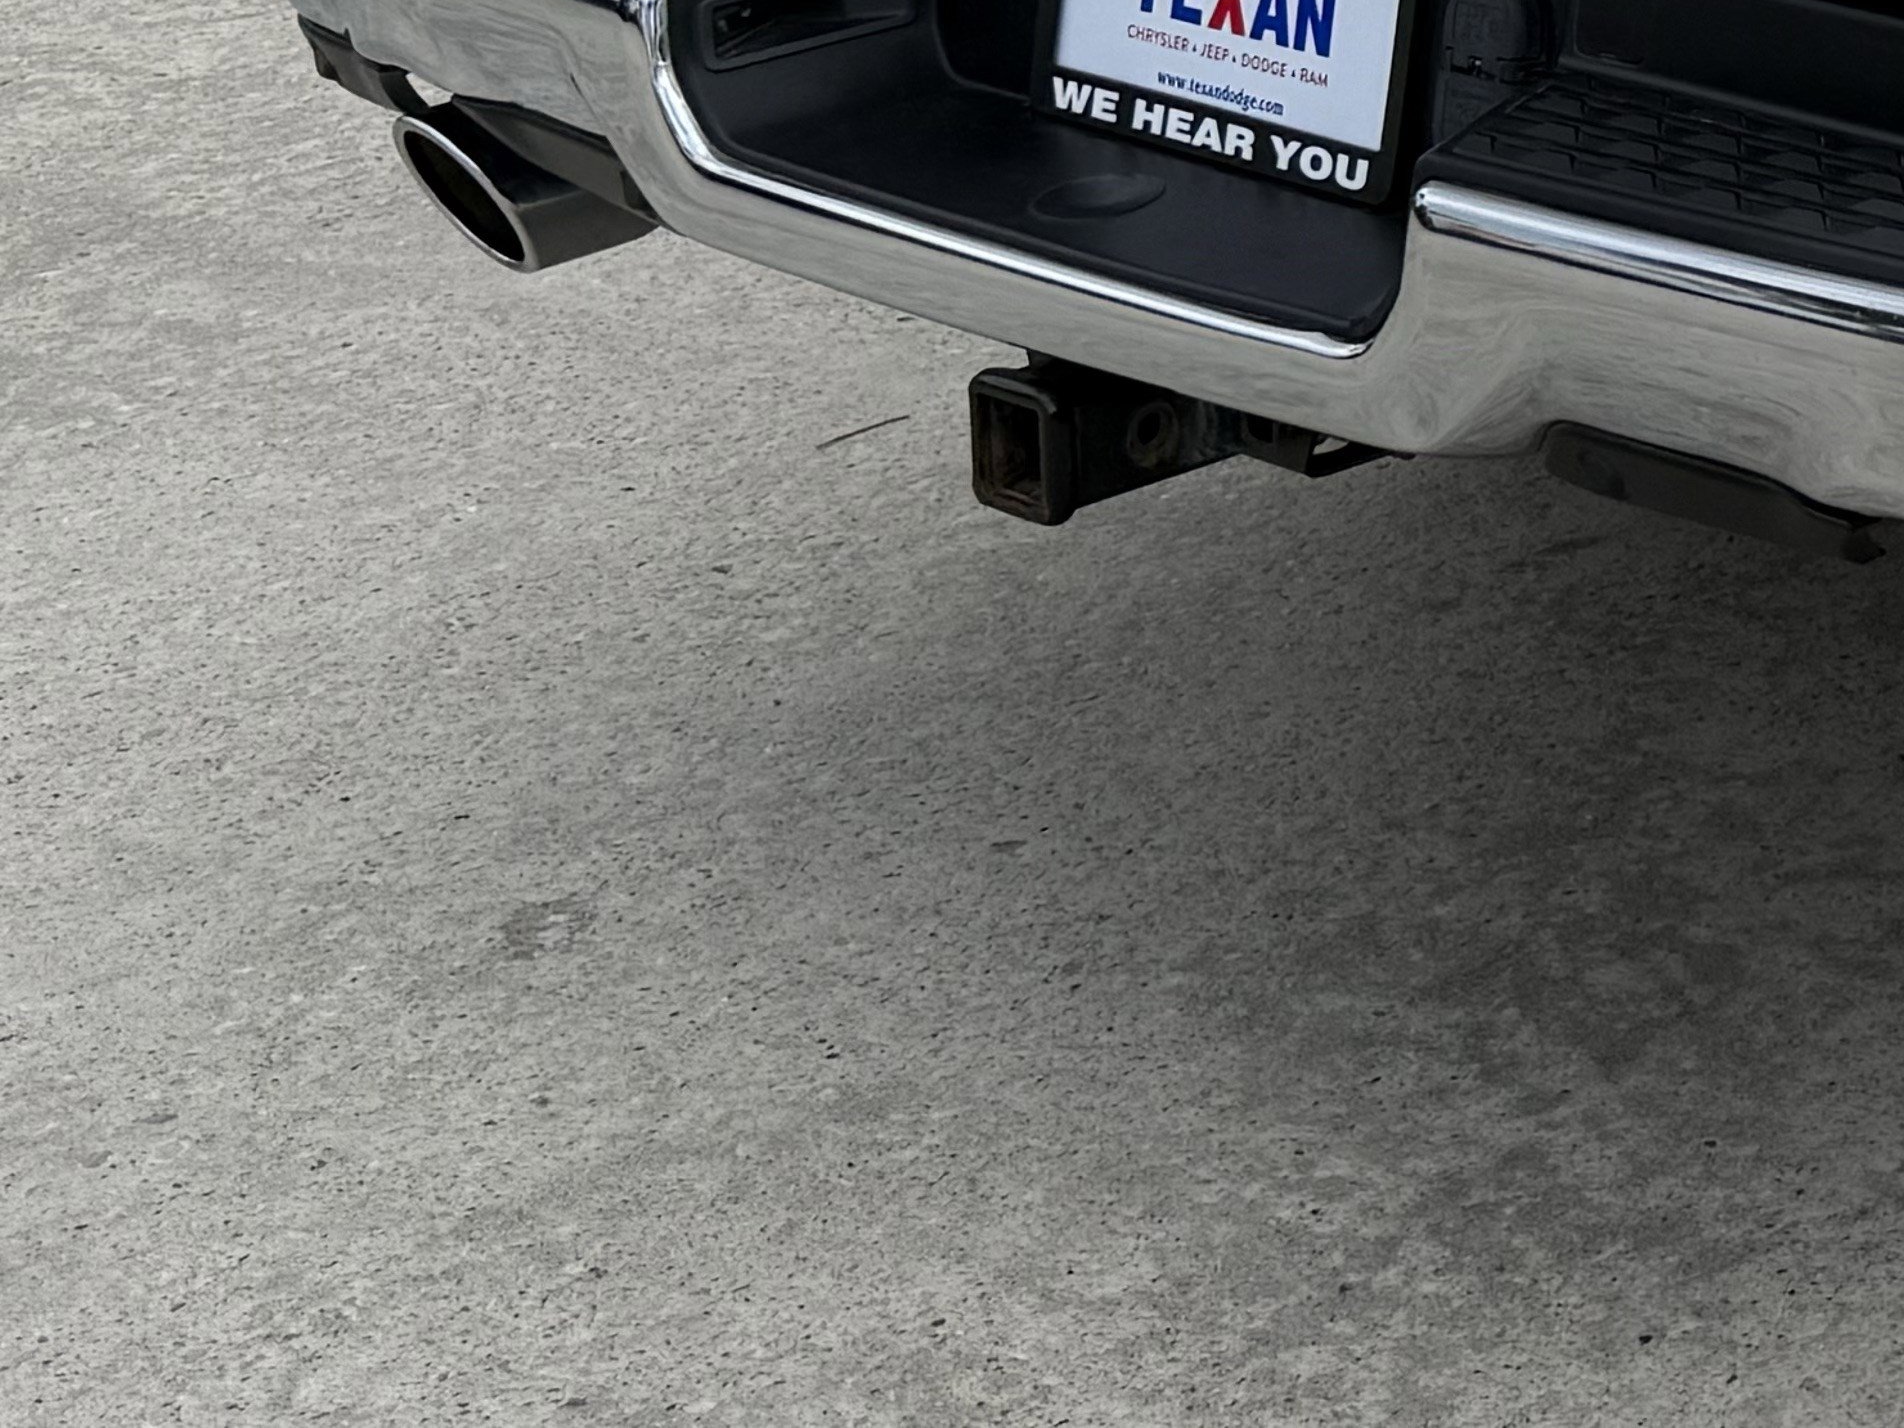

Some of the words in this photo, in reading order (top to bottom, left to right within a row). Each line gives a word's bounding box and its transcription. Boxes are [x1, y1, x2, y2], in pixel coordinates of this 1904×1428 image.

[1127, 24, 1190, 53] CHRYSLER
[1199, 43, 1230, 63] JEEP
[1241, 52, 1288, 78] DODGE
[1299, 67, 1329, 88] RAM
[1157, 71, 1285, 116] www.texandodge.com
[1052, 76, 1119, 123] WE
[1131, 98, 1255, 162] HEAR
[1270, 133, 1369, 191] YOU
